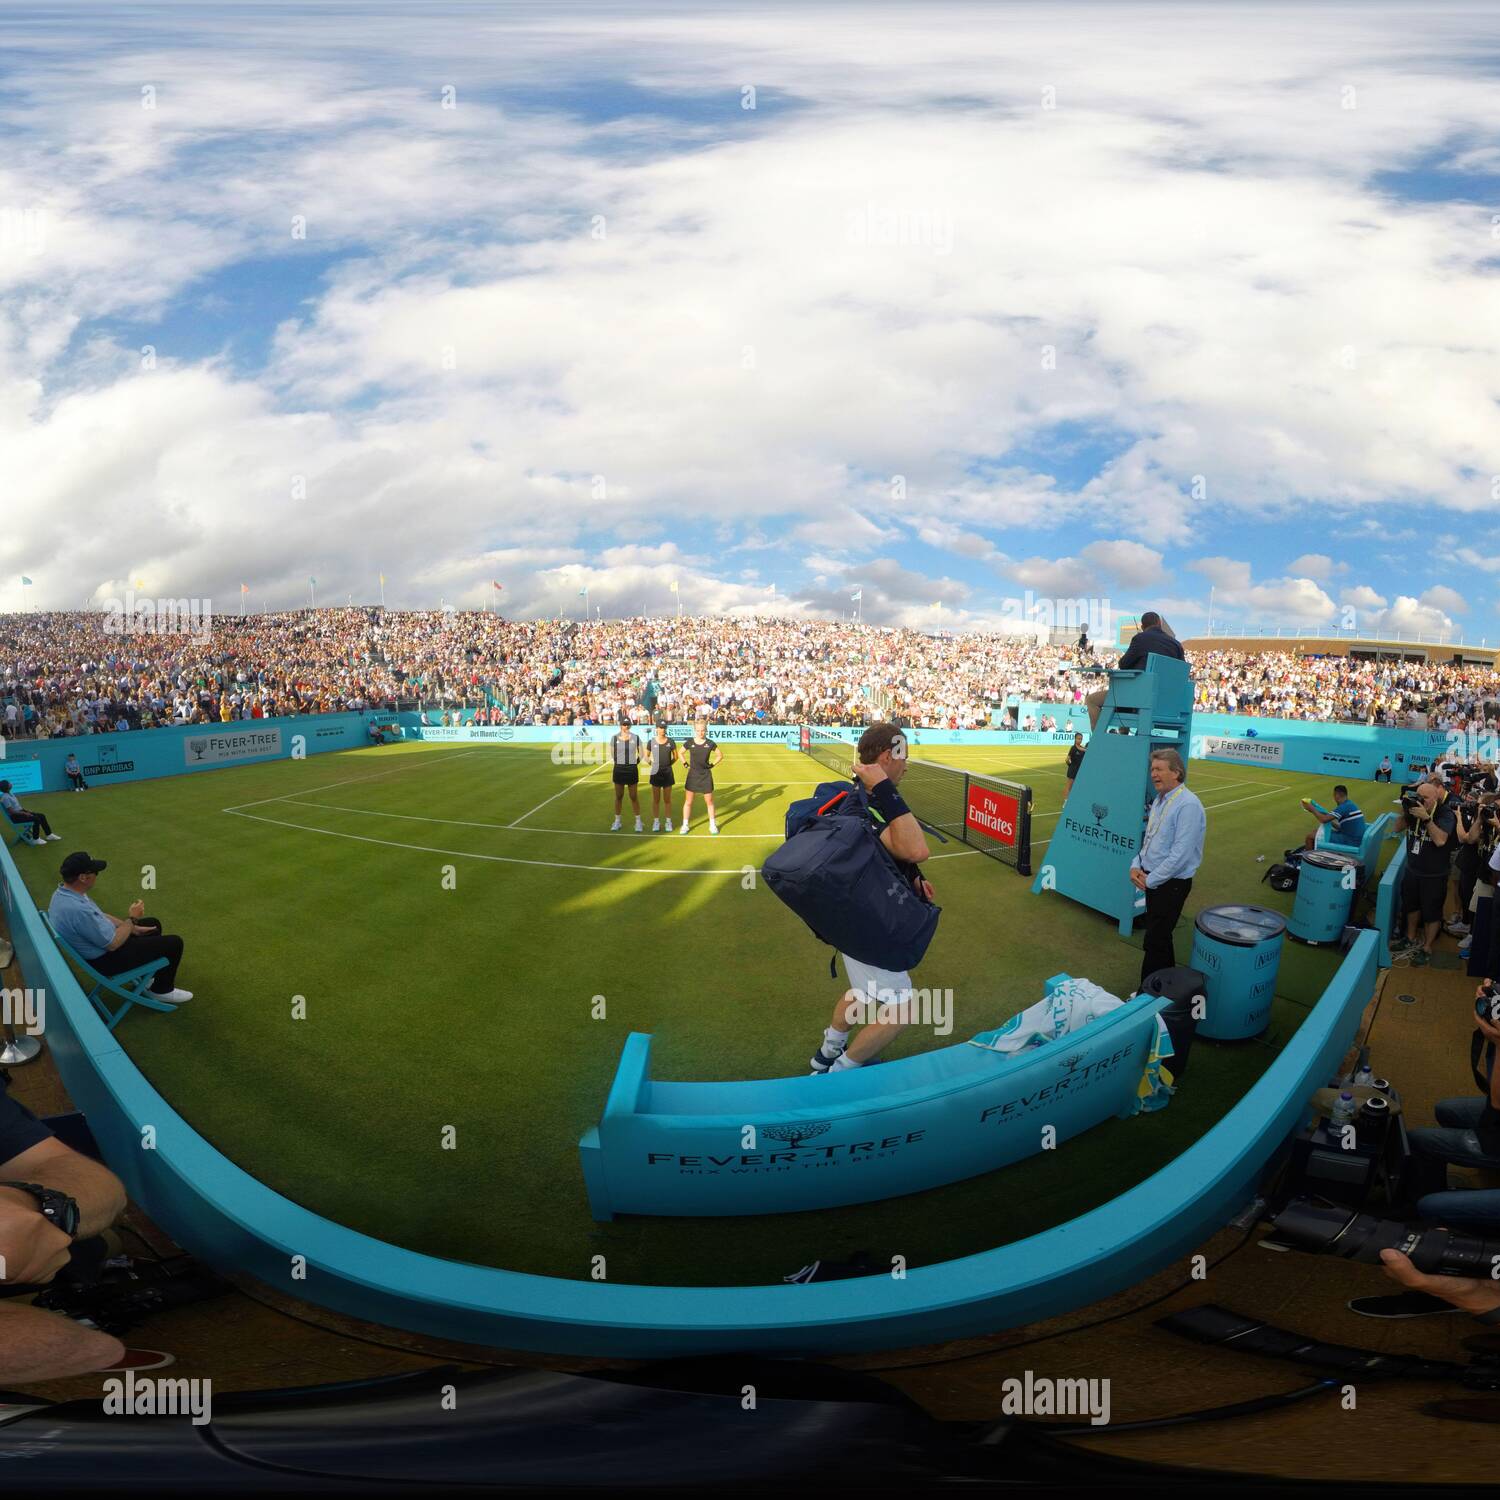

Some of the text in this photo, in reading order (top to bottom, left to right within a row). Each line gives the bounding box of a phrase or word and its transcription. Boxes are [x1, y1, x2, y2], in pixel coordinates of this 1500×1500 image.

[210, 734, 276, 750] FEVER-TREE
[760, 730, 842, 740] CHAMNSHIPS
[1052, 733, 1075, 741] RADO
[1220, 740, 1279, 755] FEVER-TREE
[84, 762, 132, 776] BNP PARIBAS
[984, 798, 997, 814] Fly
[969, 804, 1012, 836] Emirates
[1065, 818, 1135, 850] FEVER-TREE
[980, 1042, 1136, 1123] FEVER-TREE
[998, 1110, 1025, 1125] MIX
[1030, 1094, 1064, 1112] WITH
[648, 1129, 926, 1166] FEVER-TREE
[730, 1166, 791, 1174] WITH
[801, 1159, 840, 1169] THE
[852, 1149, 898, 1164] BEST
